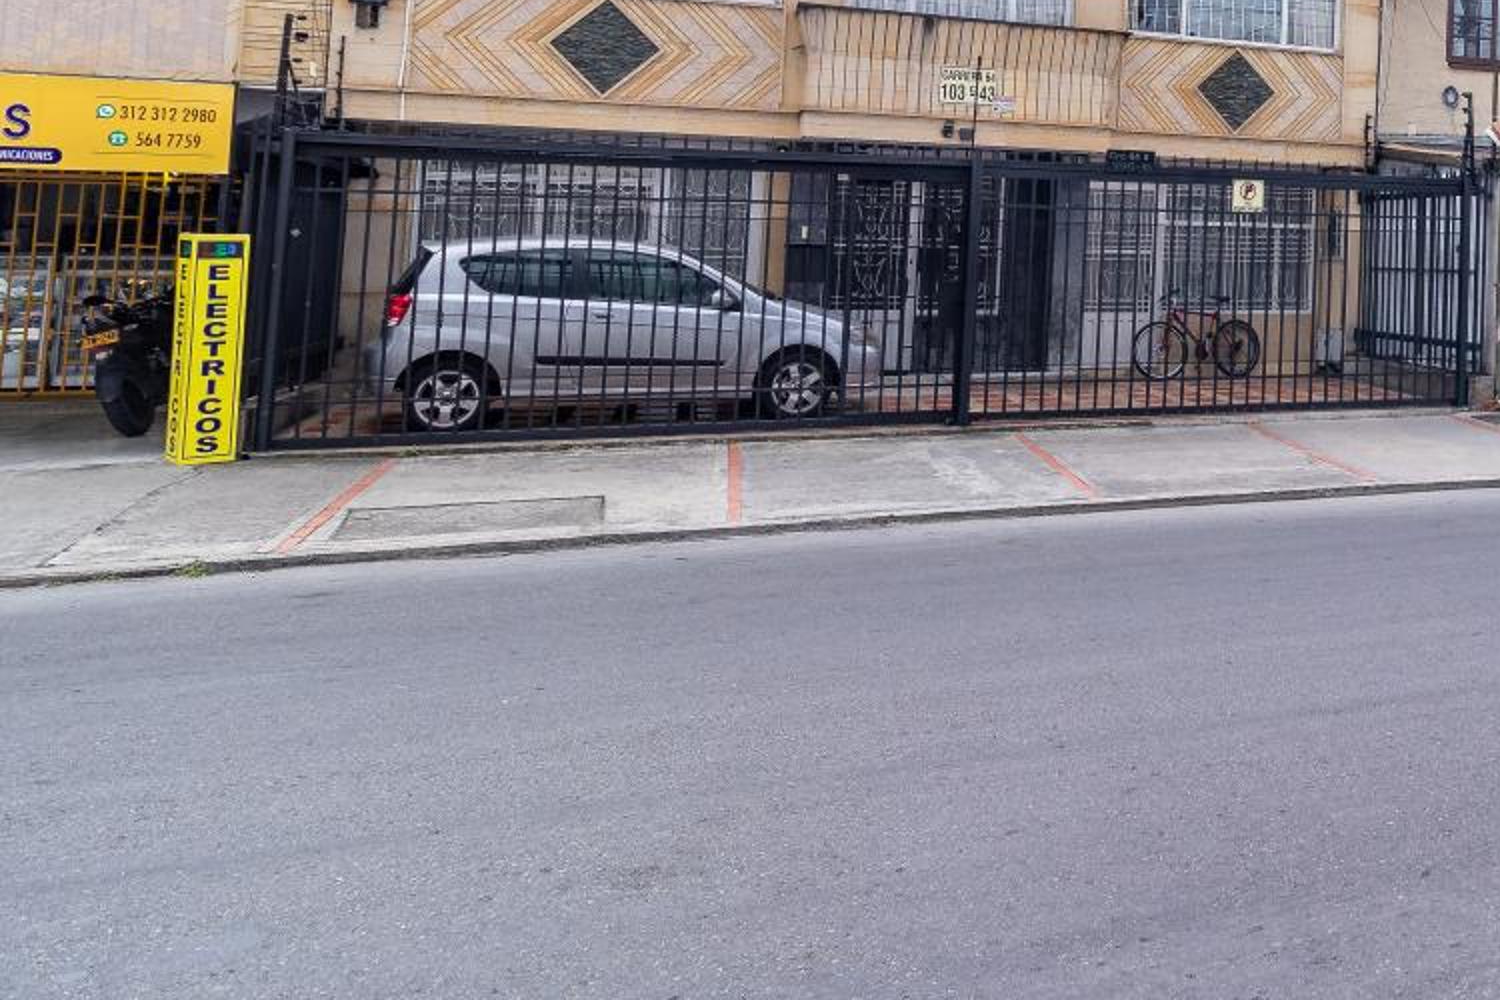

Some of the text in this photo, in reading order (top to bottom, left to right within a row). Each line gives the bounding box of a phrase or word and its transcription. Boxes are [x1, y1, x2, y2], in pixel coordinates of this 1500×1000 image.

[941, 83, 965, 101] 103
[3, 103, 31, 138] S
[119, 105, 217, 123] 312 312 2980
[134, 132, 202, 149] 564 7759
[195, 264, 231, 453] ELECTRICOS
